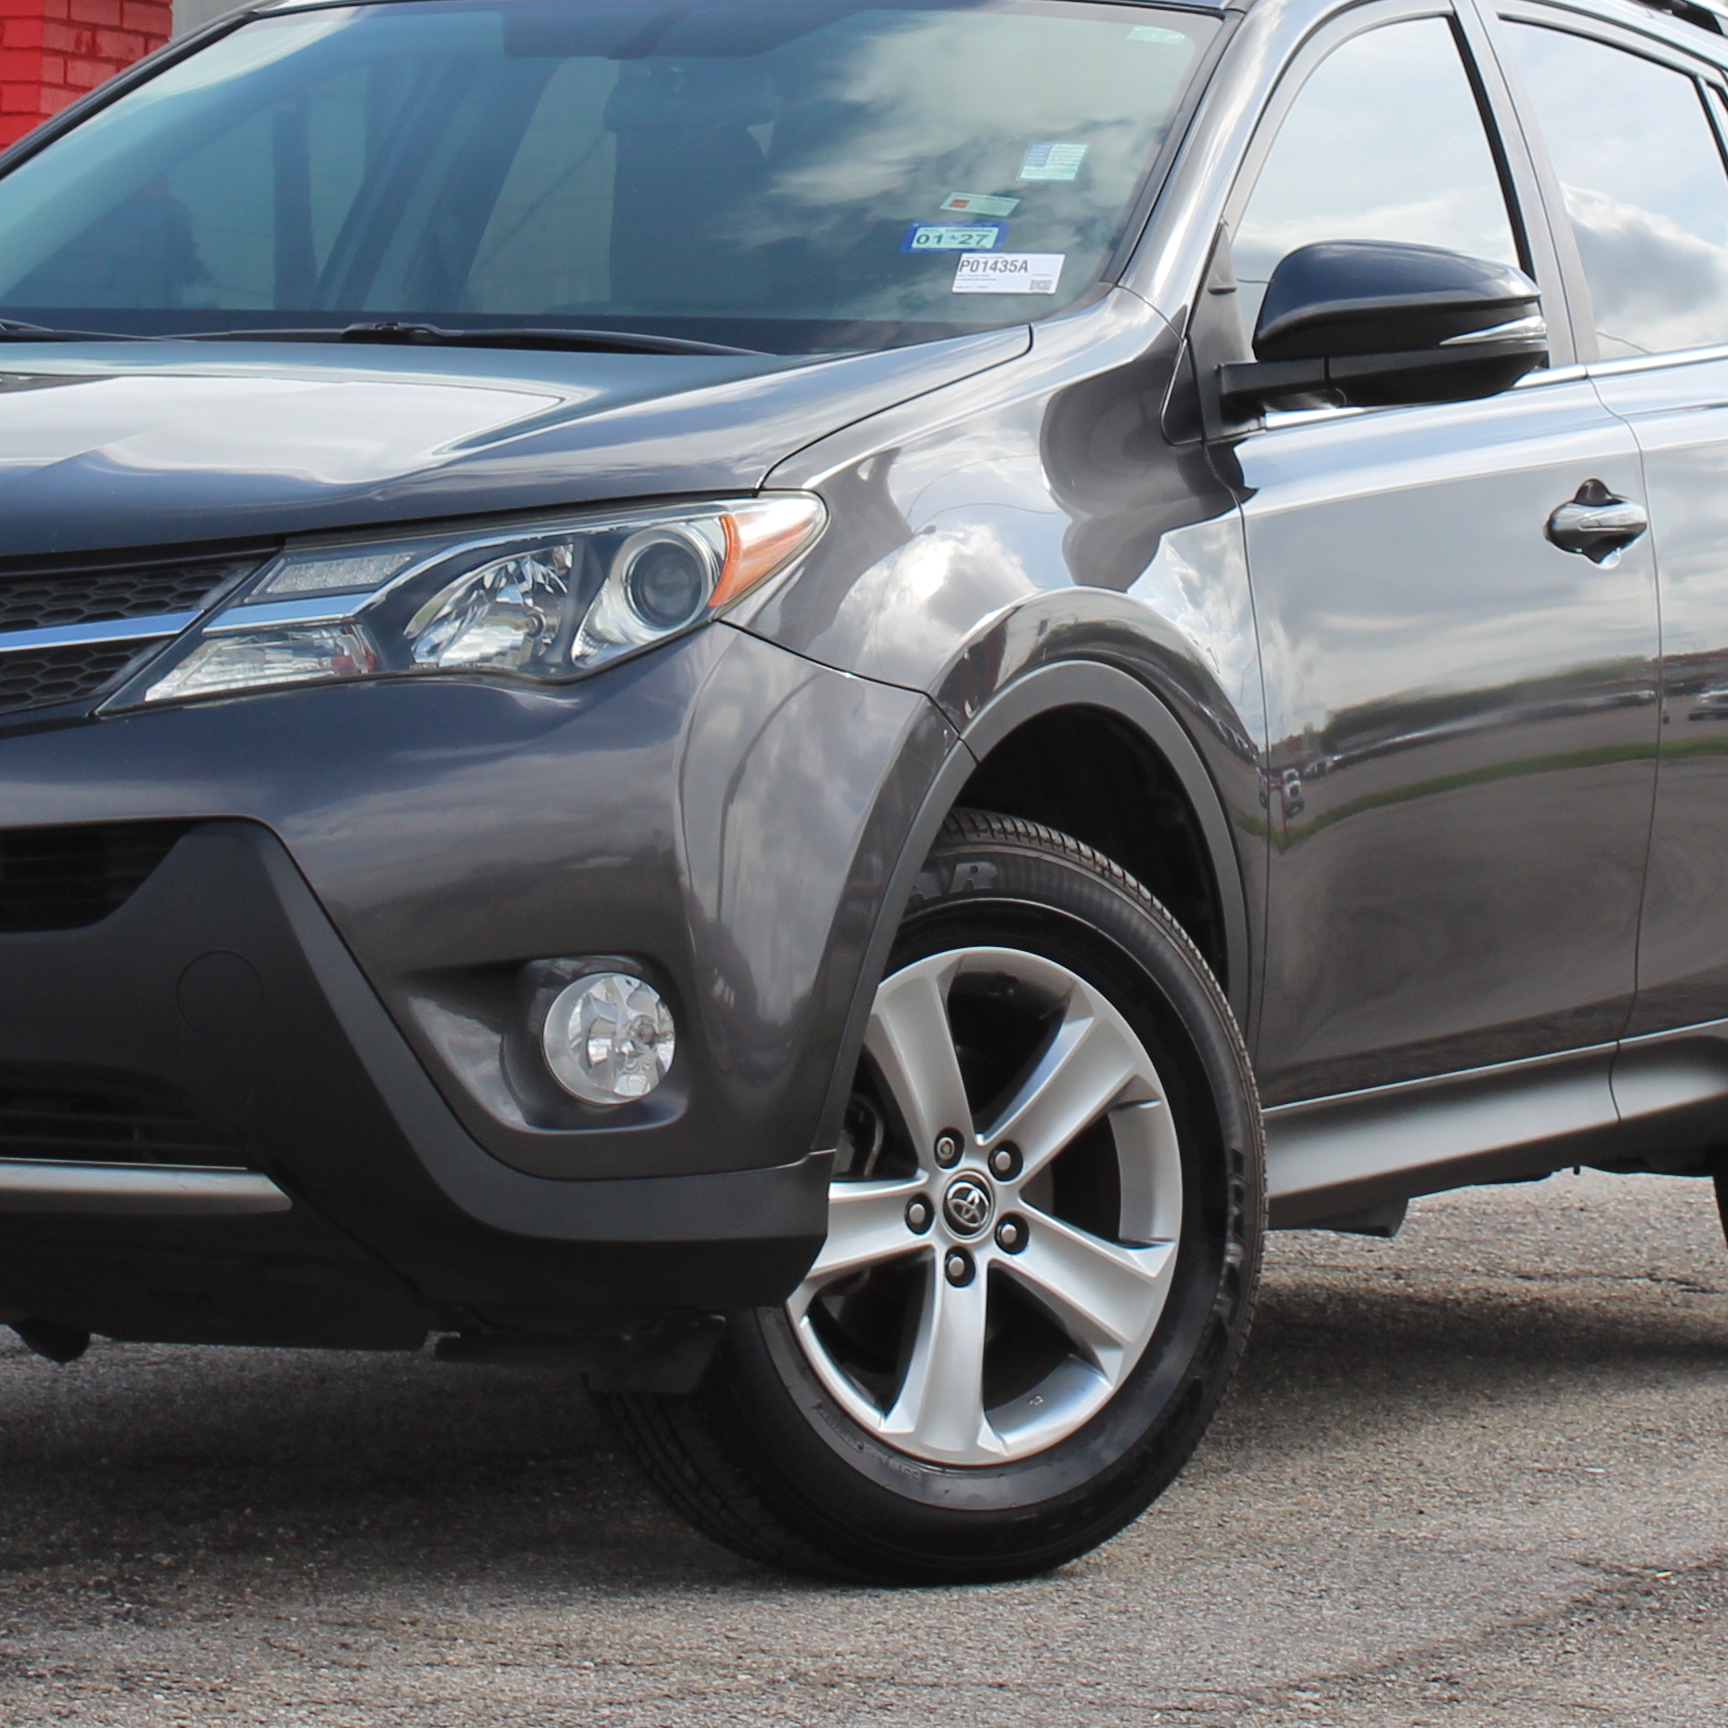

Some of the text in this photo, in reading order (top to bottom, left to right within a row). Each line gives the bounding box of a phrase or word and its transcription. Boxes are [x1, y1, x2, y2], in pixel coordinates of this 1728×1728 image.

[915, 233, 989, 246] 01 27
[958, 259, 1029, 274] P01435A
